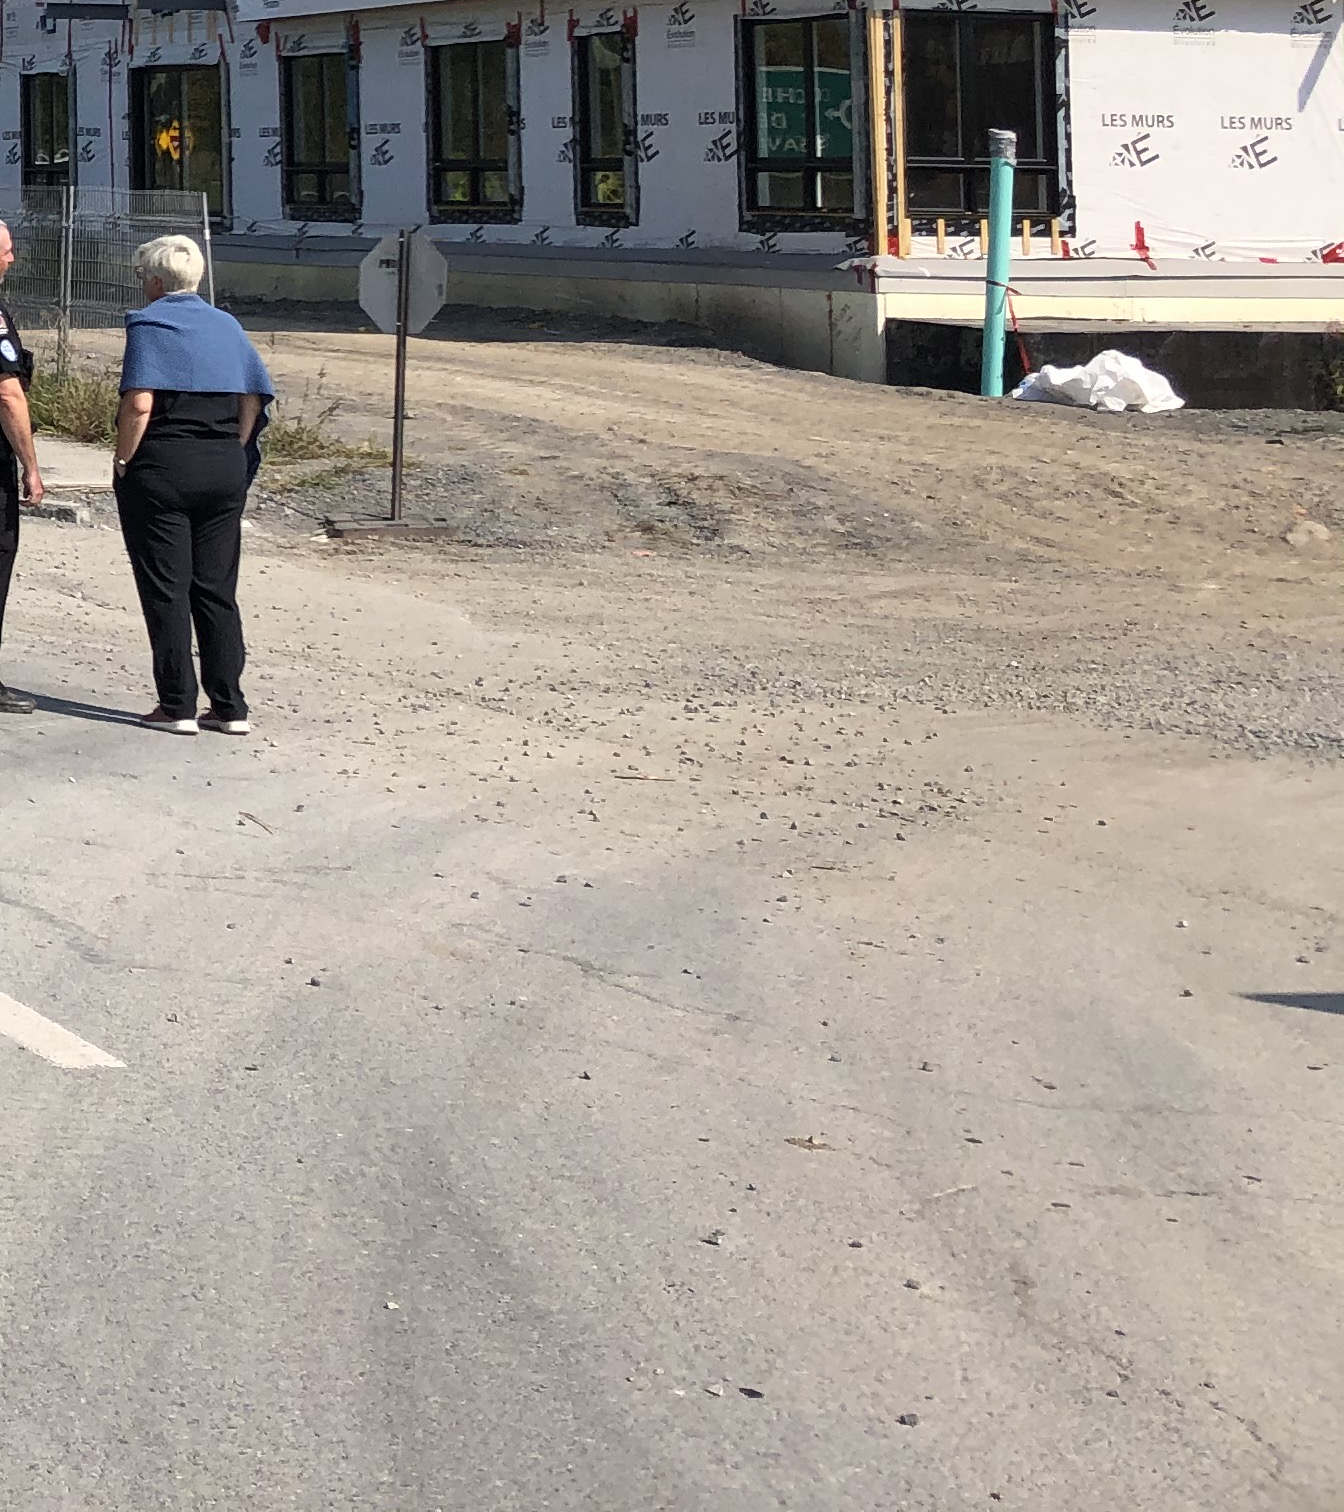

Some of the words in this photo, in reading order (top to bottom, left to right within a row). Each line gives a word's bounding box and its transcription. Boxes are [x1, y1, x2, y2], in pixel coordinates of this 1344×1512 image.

[1101, 114, 1128, 127] LES
[1131, 114, 1175, 128] MURS
[1220, 116, 1246, 129] LES
[1249, 117, 1293, 131] MURS
